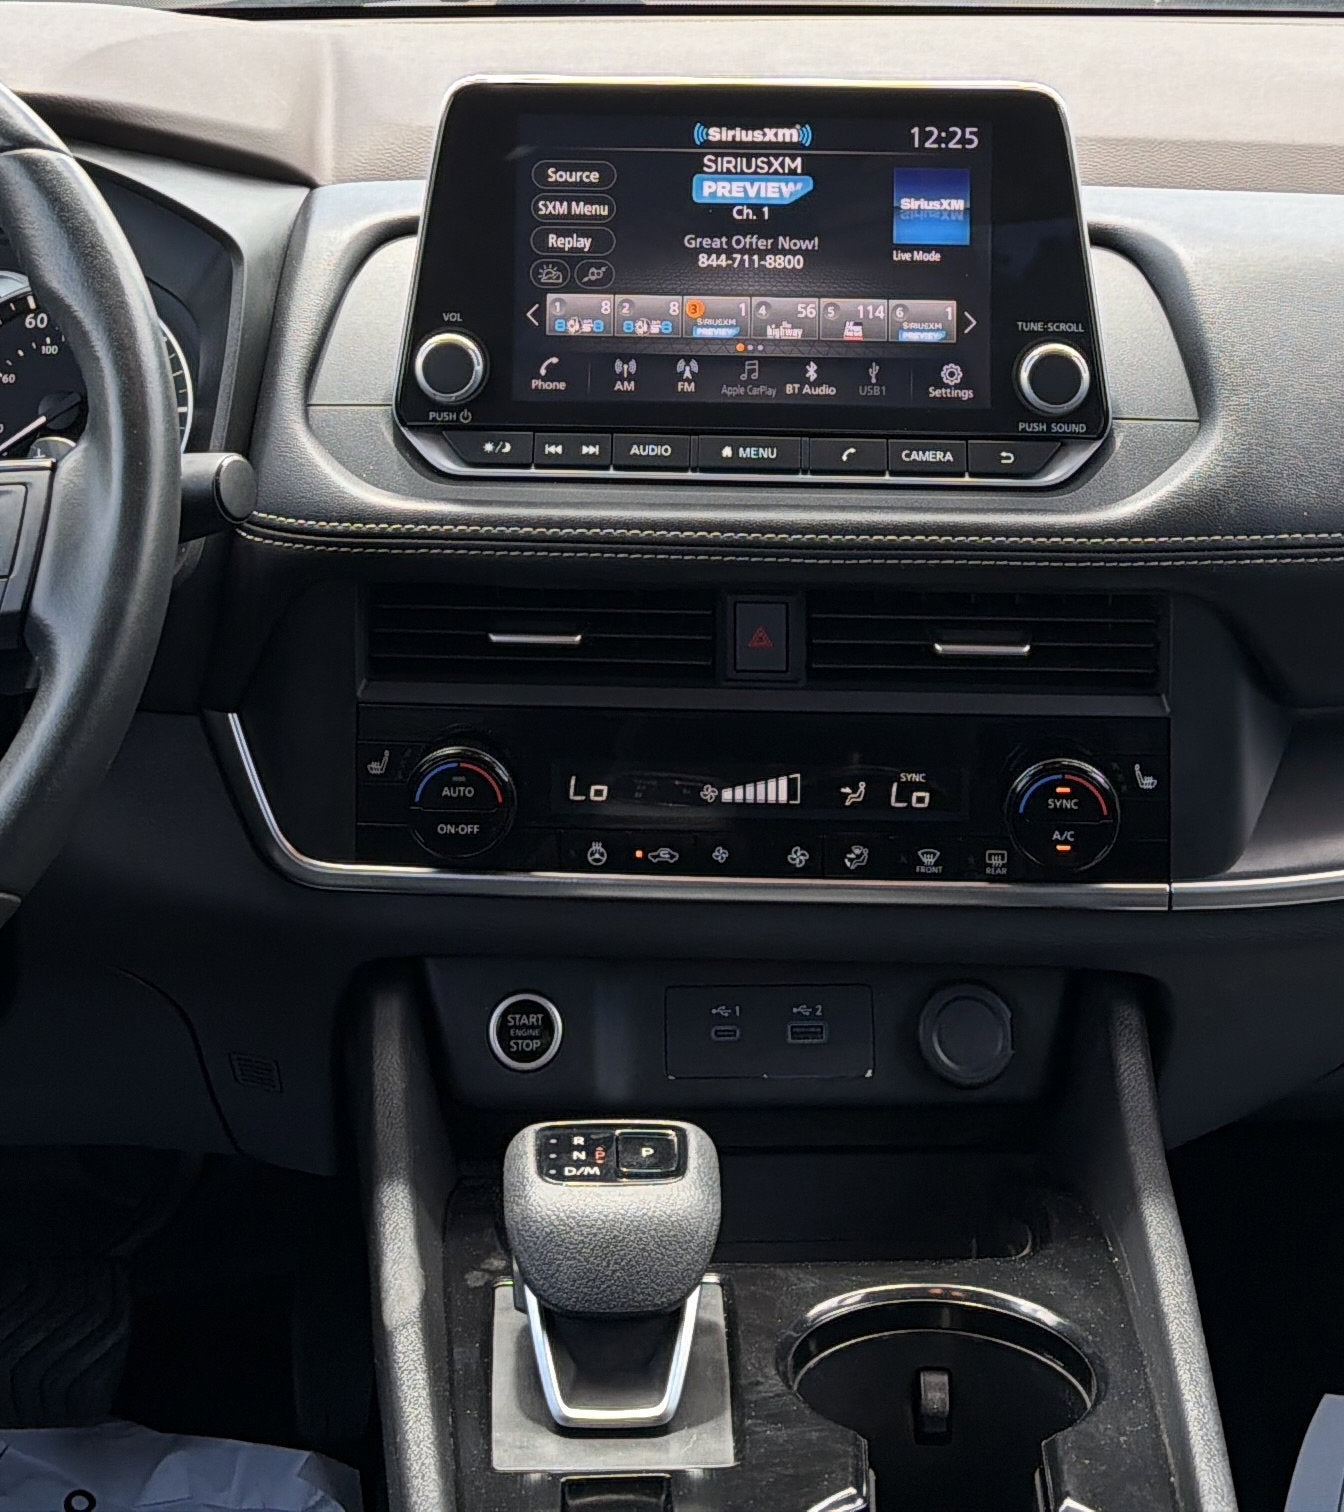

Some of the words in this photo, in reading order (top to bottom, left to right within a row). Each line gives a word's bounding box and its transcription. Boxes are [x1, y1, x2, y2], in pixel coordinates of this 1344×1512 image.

[910, 126, 979, 149] 12:25
[702, 154, 803, 174] SIRIUSXM
[547, 168, 600, 183] Source
[702, 180, 804, 199] PREVIEW
[537, 200, 568, 215] SXM
[571, 201, 609, 216] Menu
[732, 205, 757, 220] Ch.
[762, 206, 770, 220] 1
[548, 234, 593, 251] Replay
[684, 234, 728, 249] Great
[731, 234, 775, 249] Offer
[778, 236, 819, 250] Now!
[698, 253, 804, 269] 844-711-8800
[892, 250, 912, 262] Live
[913, 250, 942, 262] Mode
[600, 299, 612, 316] 8
[621, 302, 631, 314] 2
[668, 300, 681, 317] 8
[738, 302, 746, 317] 1
[758, 305, 767, 316] 4
[796, 303, 817, 319] 56
[826, 306, 835, 317] 5
[856, 304, 886, 320] 114
[895, 306, 904, 318] 6
[945, 306, 953, 321] 1
[24, 313, 48, 329] 60
[442, 312, 463, 322] VOL
[766, 324, 803, 339] highway
[40, 345, 59, 356] 100
[1, 373, 16, 384] 60
[531, 379, 567, 391] Phone
[614, 381, 635, 392] AM
[678, 382, 695, 393] FM
[721, 385, 745, 397] Apple
[747, 385, 777, 398] CarPlay
[785, 384, 802, 396] BT
[803, 384, 837, 396] Audio
[859, 385, 886, 396] USB1
[929, 386, 974, 400] Settings
[428, 411, 457, 422] PUSH
[1018, 422, 1047, 433] PUSH
[1050, 422, 1087, 434] SOUND
[629, 444, 672, 456] AUDIO
[738, 446, 777, 460] MENU
[901, 449, 954, 463] CAMERA
[899, 772, 927, 784] SYNC
[441, 786, 475, 799] AUTO
[568, 775, 608, 802] Lo
[890, 782, 930, 809] Lo
[1047, 798, 1080, 811] SYNC
[1051, 829, 1076, 843] A/C
[915, 865, 943, 875] FRONT
[985, 866, 1008, 876] REAR
[814, 1004, 823, 1016] 2
[507, 1013, 545, 1027] START
[510, 1028, 541, 1038] ENGINE
[509, 1038, 542, 1053] STOP
[572, 1136, 585, 1146] R
[572, 1150, 587, 1161] N
[641, 1147, 655, 1158] P
[564, 1166, 601, 1177] D/M
